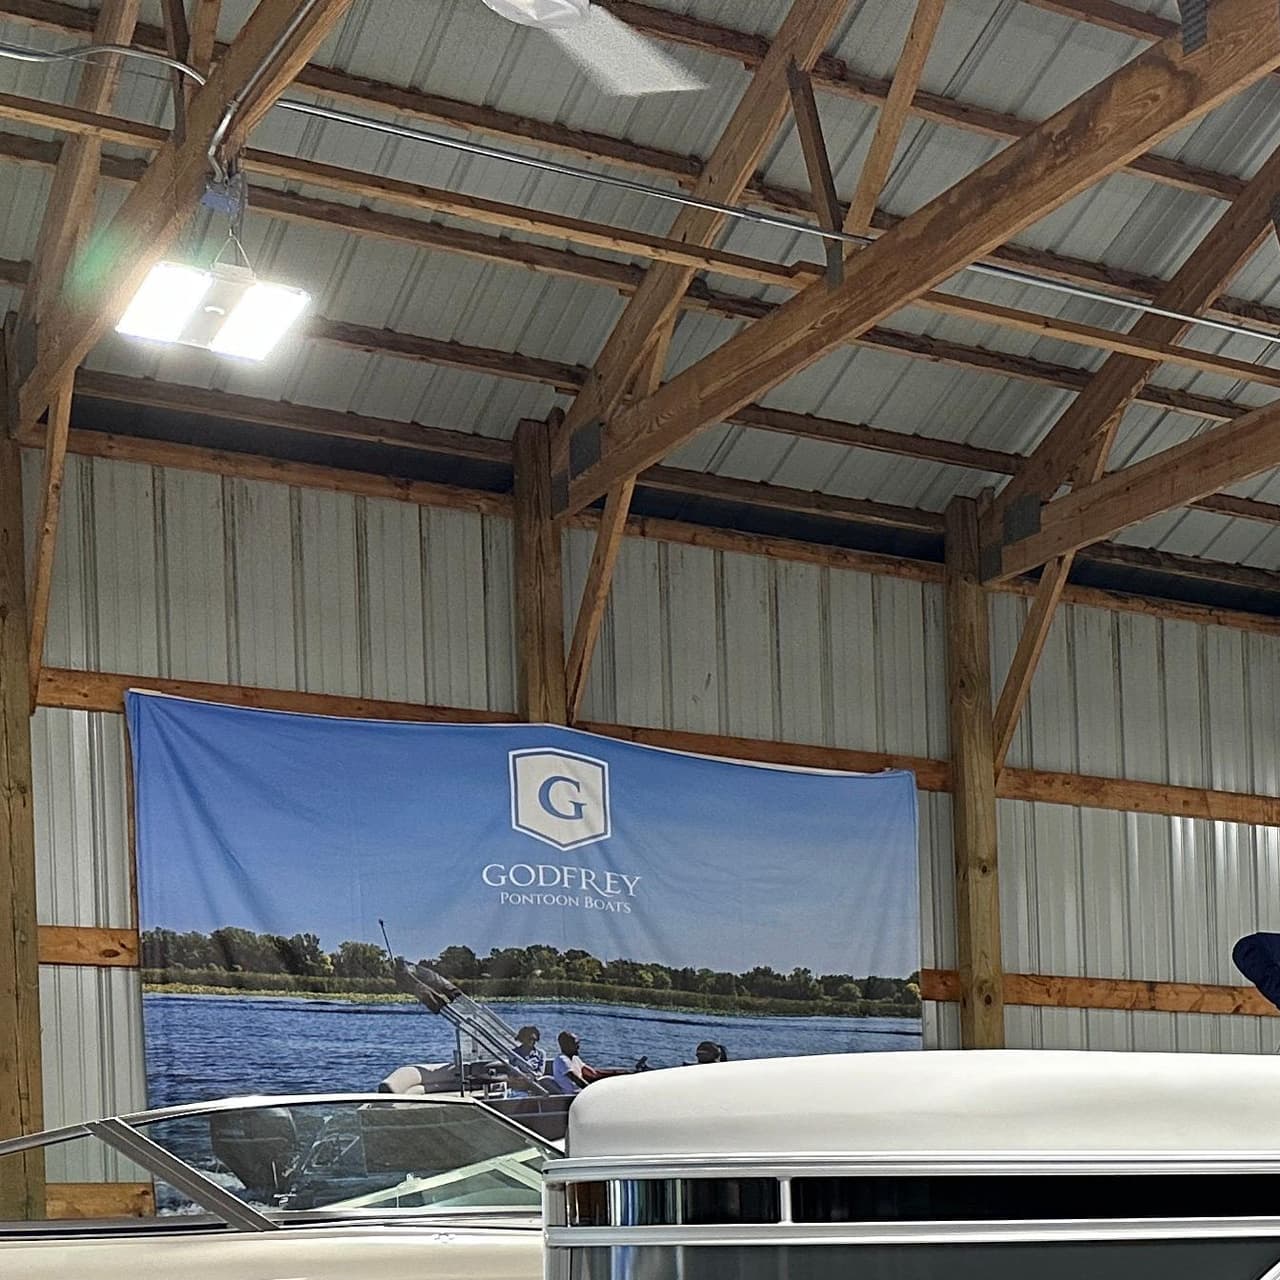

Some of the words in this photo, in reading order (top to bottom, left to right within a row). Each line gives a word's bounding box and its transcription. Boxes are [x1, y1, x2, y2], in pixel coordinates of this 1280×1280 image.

[538, 775, 587, 820] G
[482, 864, 643, 897] GODFREY
[500, 891, 580, 907] PONTOON
[584, 896, 632, 914] BOATS
